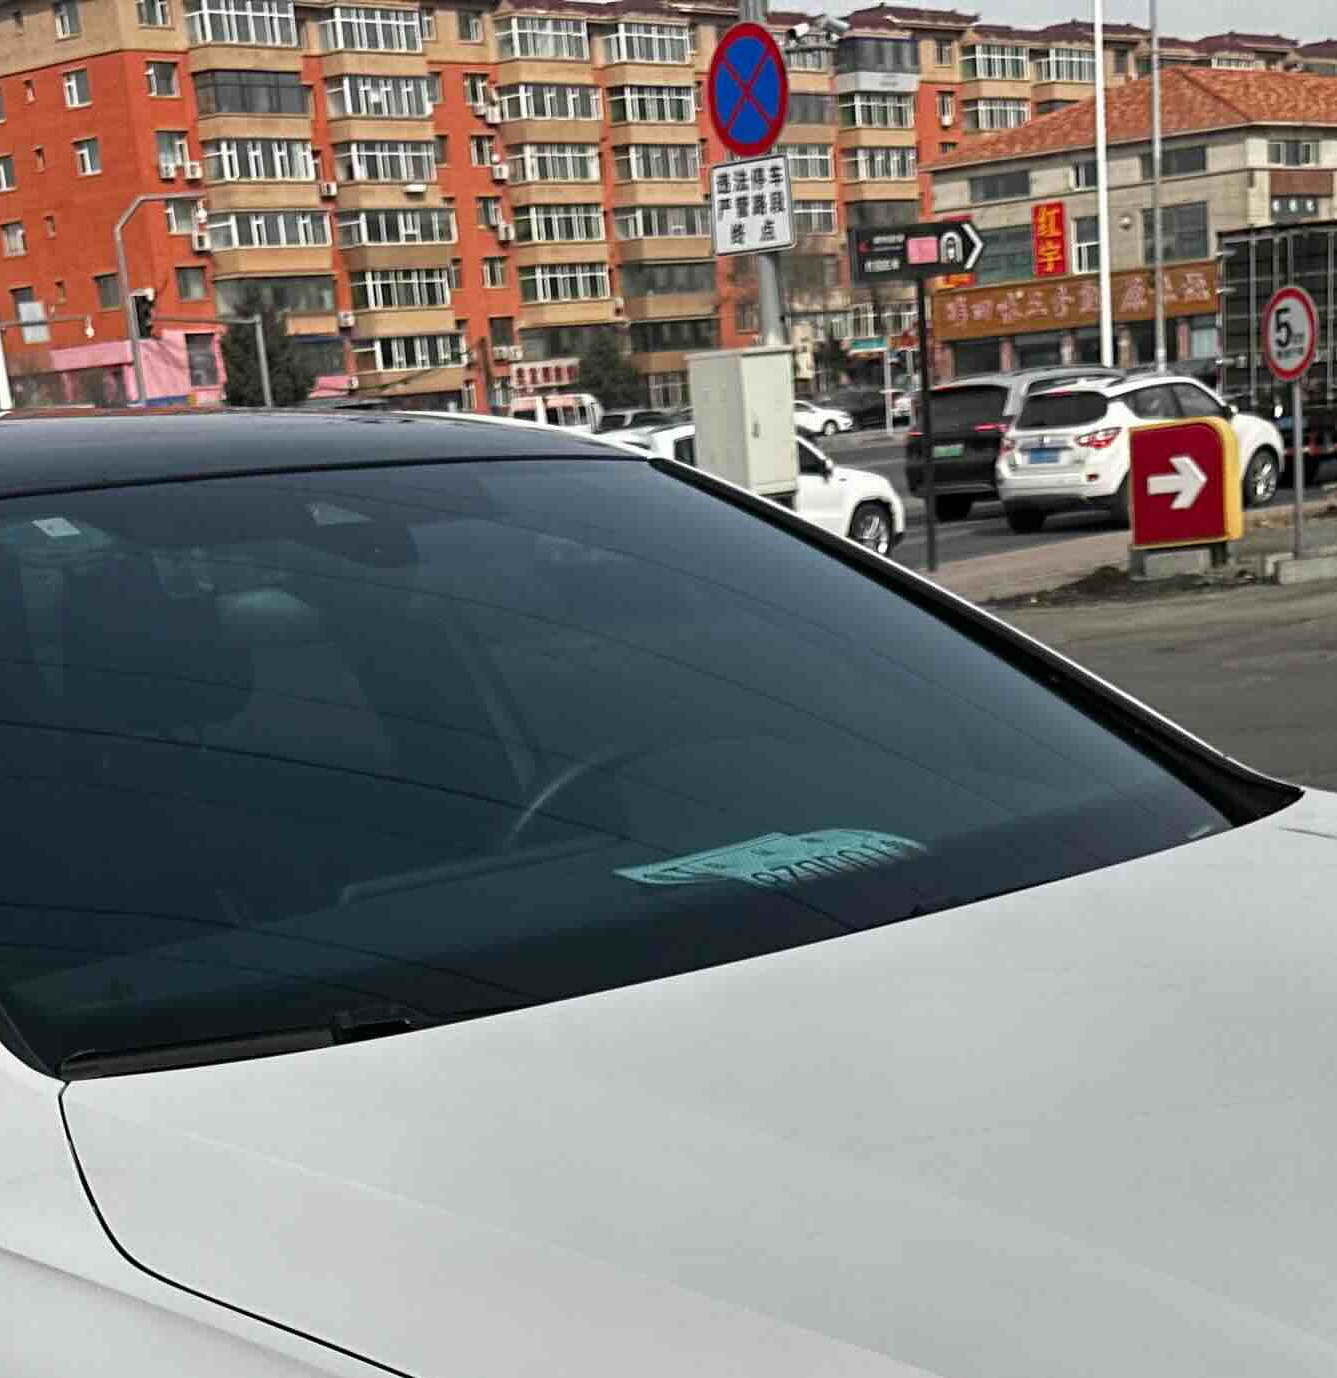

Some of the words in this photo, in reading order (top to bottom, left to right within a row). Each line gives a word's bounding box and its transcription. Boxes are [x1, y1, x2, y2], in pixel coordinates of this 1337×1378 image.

[717, 166, 784, 194] 违法停车
[730, 220, 777, 244] 终点
[1275, 307, 1292, 348] 5
